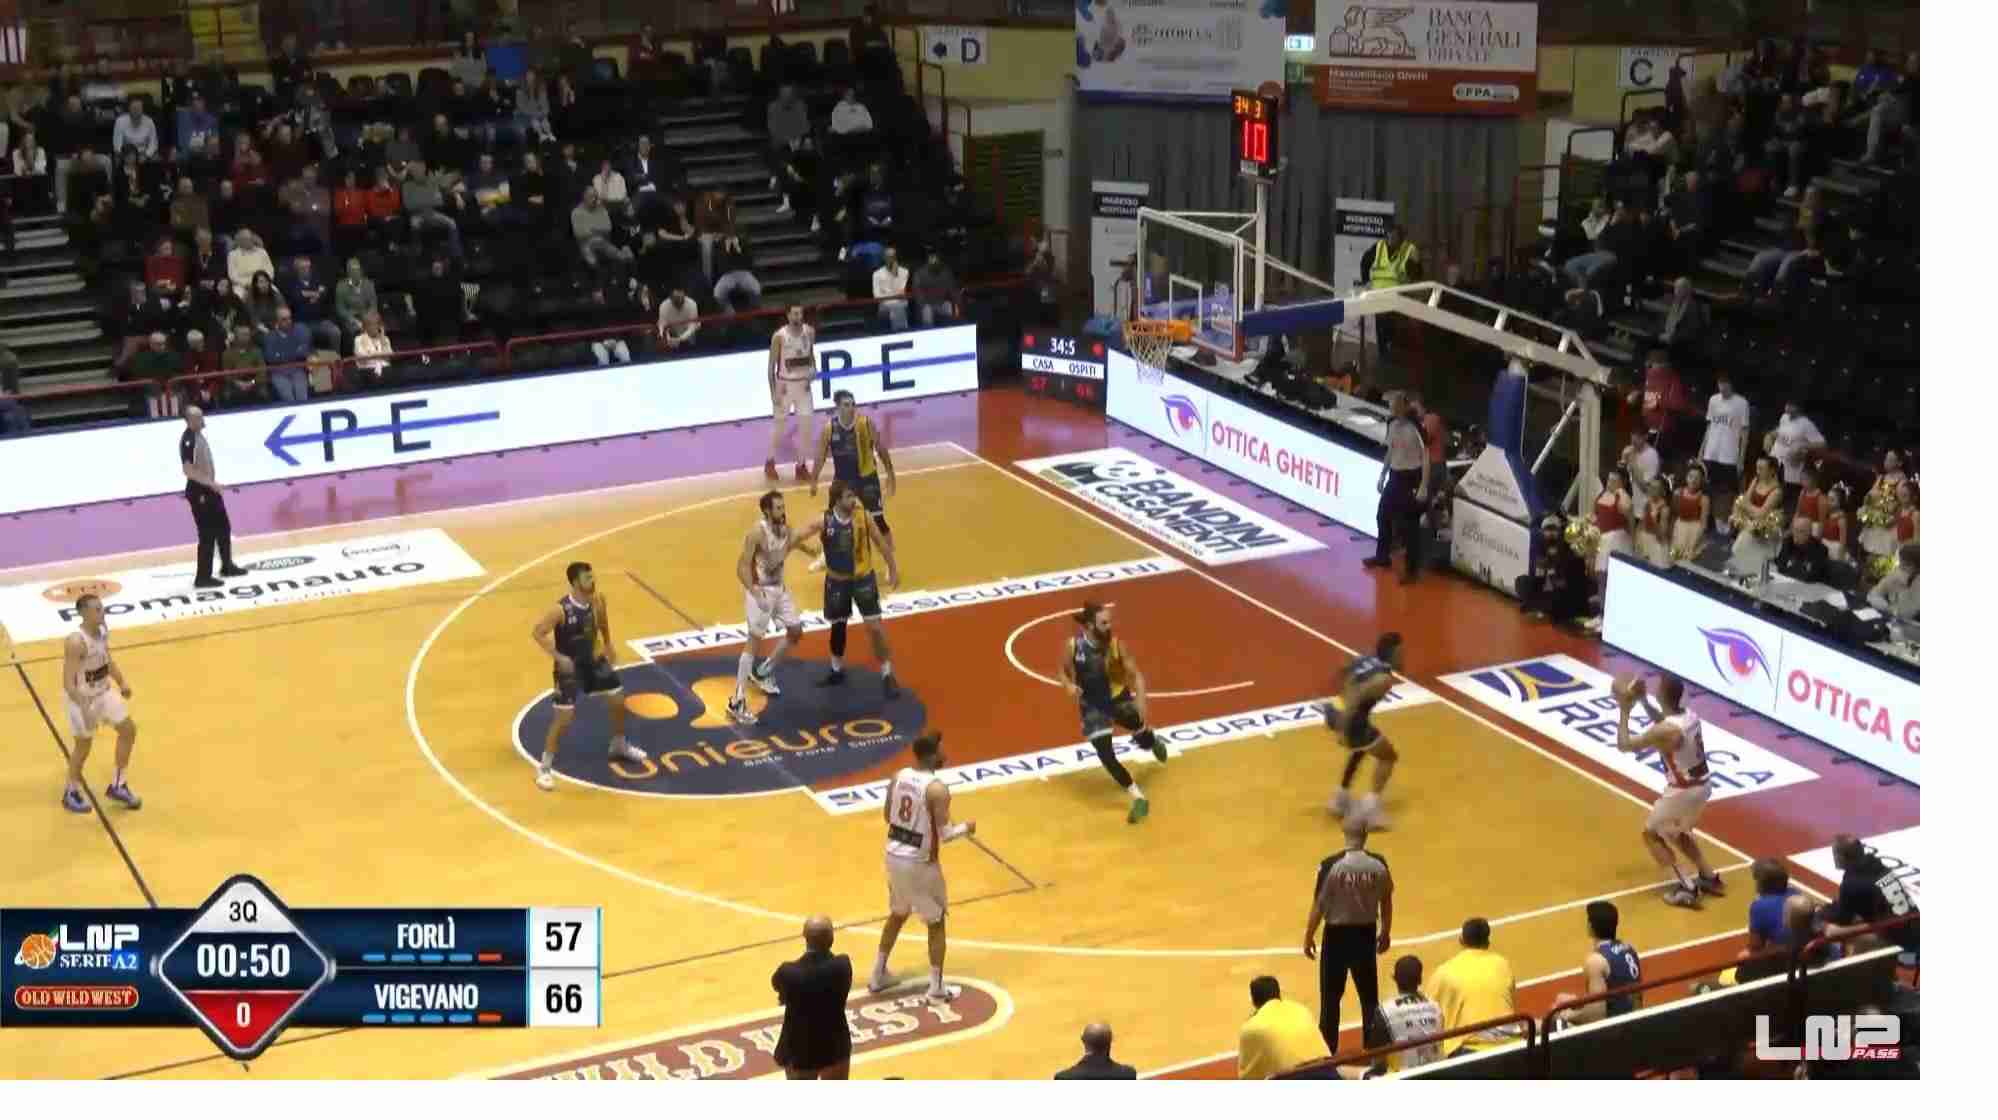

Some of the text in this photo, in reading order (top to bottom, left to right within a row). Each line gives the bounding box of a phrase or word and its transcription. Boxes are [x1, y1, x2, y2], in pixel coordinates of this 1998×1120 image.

[1428, 7, 1494, 27] BANCA
[960, 38, 981, 62] D
[1426, 29, 1521, 49] GENERALI
[1630, 59, 1653, 86] C
[1243, 120, 1267, 162] 10
[1050, 336, 1076, 356] 34:5
[1032, 358, 1097, 377] CASA OSPITI
[1211, 420, 1341, 497] OTTICA GHETTI
[1096, 484, 1246, 553] CASAMENTI
[1127, 478, 1288, 547] BANDINI
[1787, 669, 1892, 742] OTTICA
[607, 718, 894, 778] unieuro
[899, 794, 912, 822] 8
[1625, 952, 1639, 979] 8
